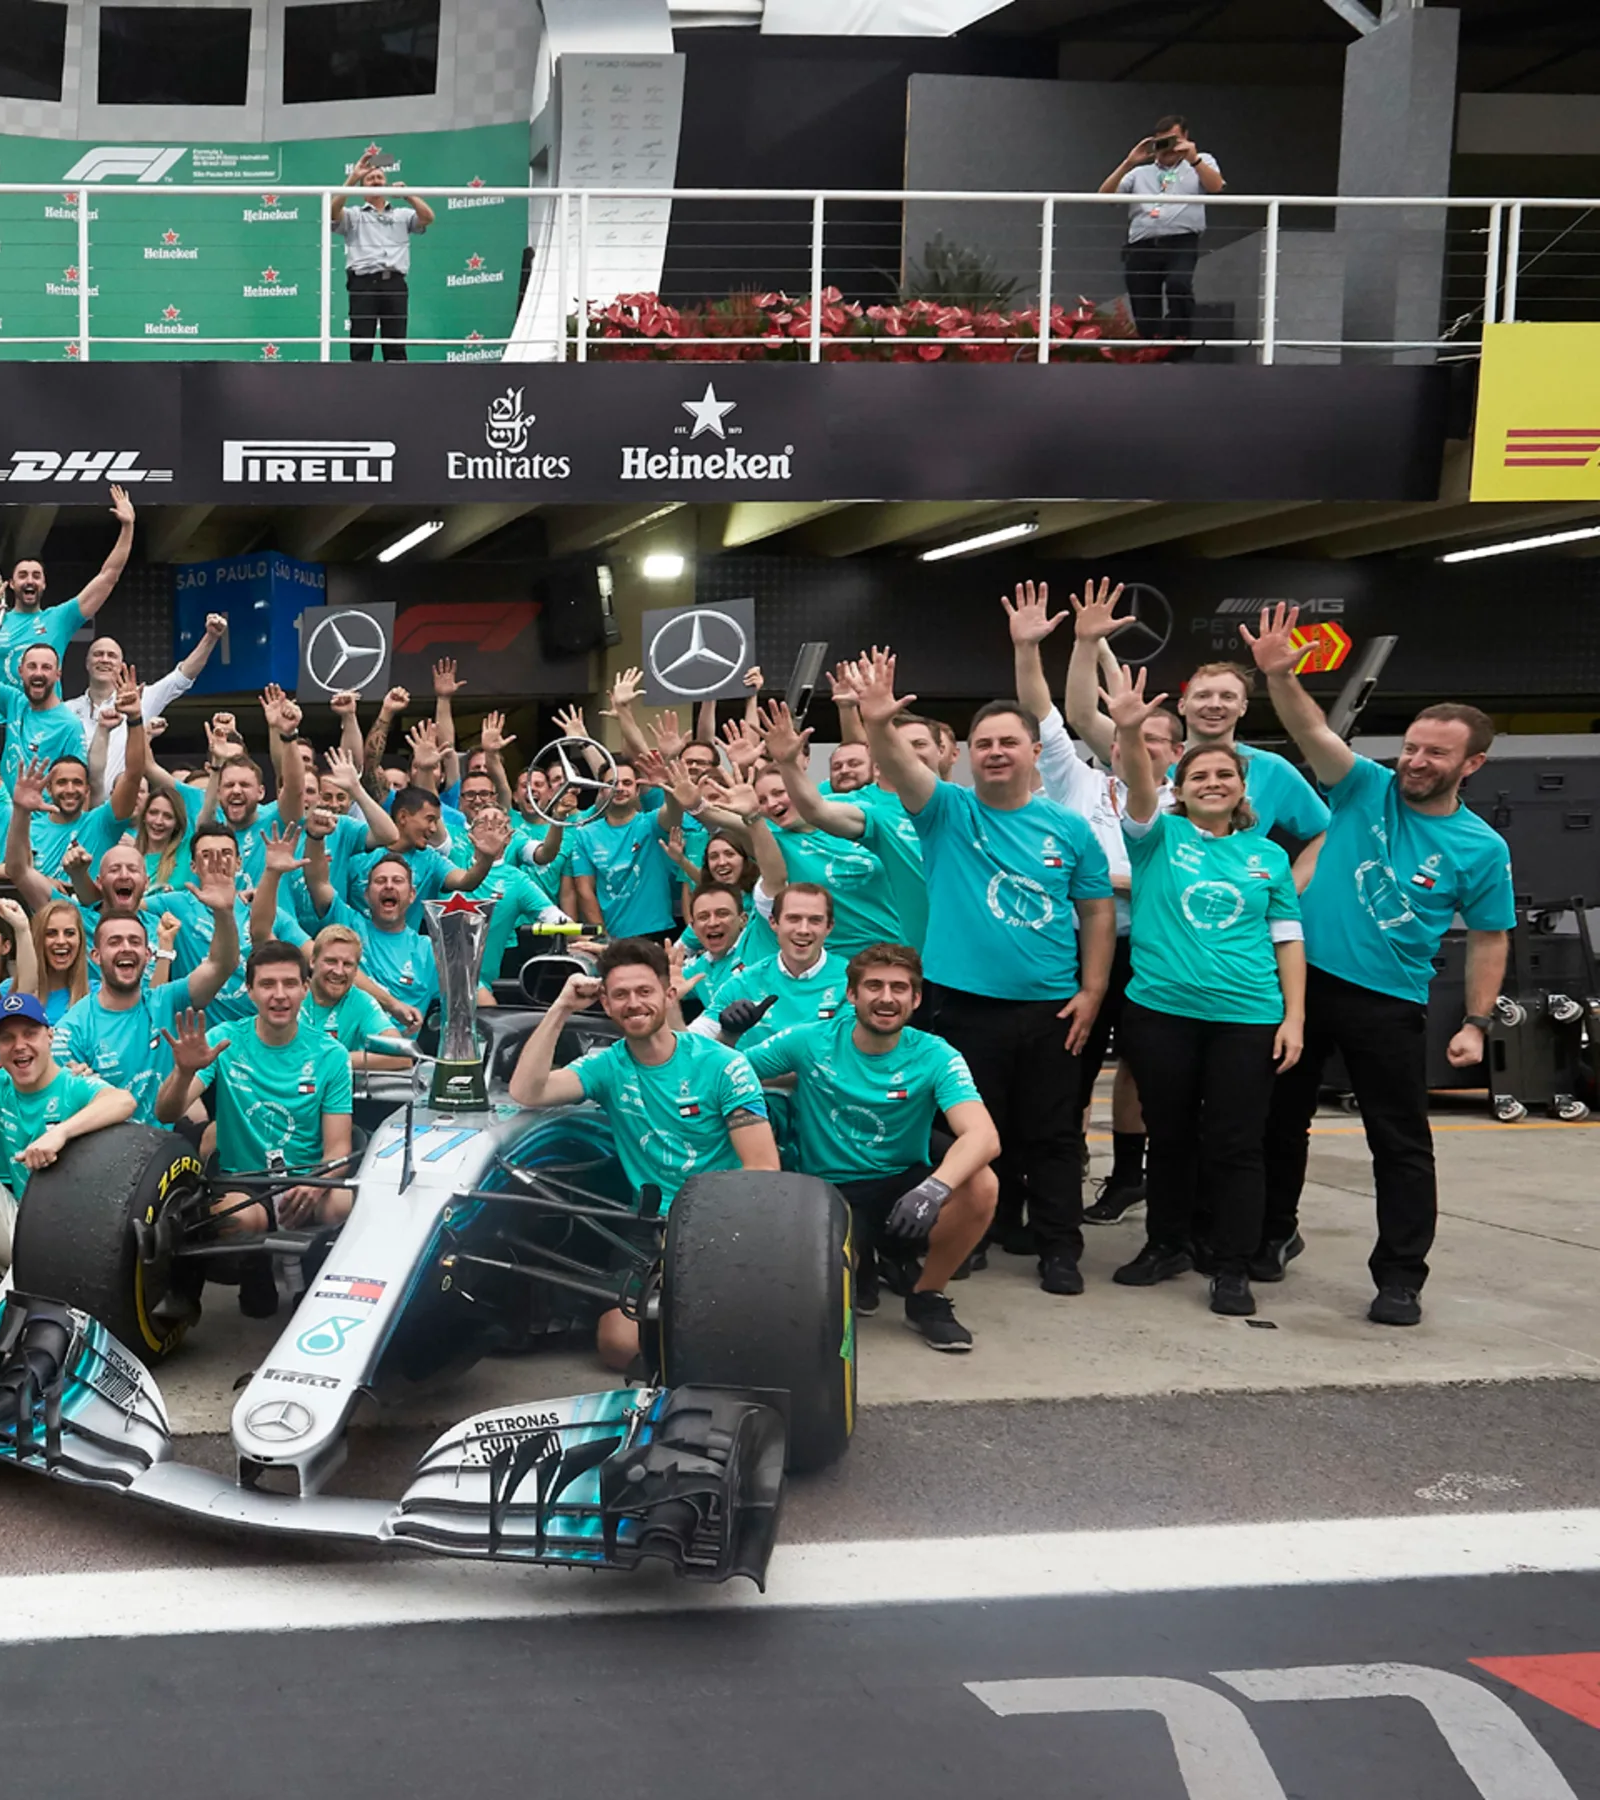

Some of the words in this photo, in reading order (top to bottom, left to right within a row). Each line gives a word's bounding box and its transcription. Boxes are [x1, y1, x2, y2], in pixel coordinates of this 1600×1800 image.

[243, 207, 298, 221] Heineken
[448, 196, 504, 210] Heineken
[144, 247, 199, 259] Heineken
[243, 284, 298, 297] Heineken
[447, 270, 504, 287] Heineken
[145, 322, 199, 334] Heineken
[446, 347, 504, 362] Heineken
[5, 451, 152, 482] DHL
[223, 440, 396, 482] PIRELLI
[447, 451, 571, 480] Emirates
[620, 447, 793, 480] Heineken
[176, 569, 207, 591] SÃO
[216, 561, 267, 583] PAULO
[274, 559, 290, 581] SÃO
[294, 568, 325, 589] PAULO
[376, 1124, 483, 1162] 77
[157, 1156, 202, 1200] ZERO
[107, 1348, 142, 1382] PETRONAS
[263, 1368, 341, 1389] PIRELLI
[474, 1412, 560, 1434] PETRONAS
